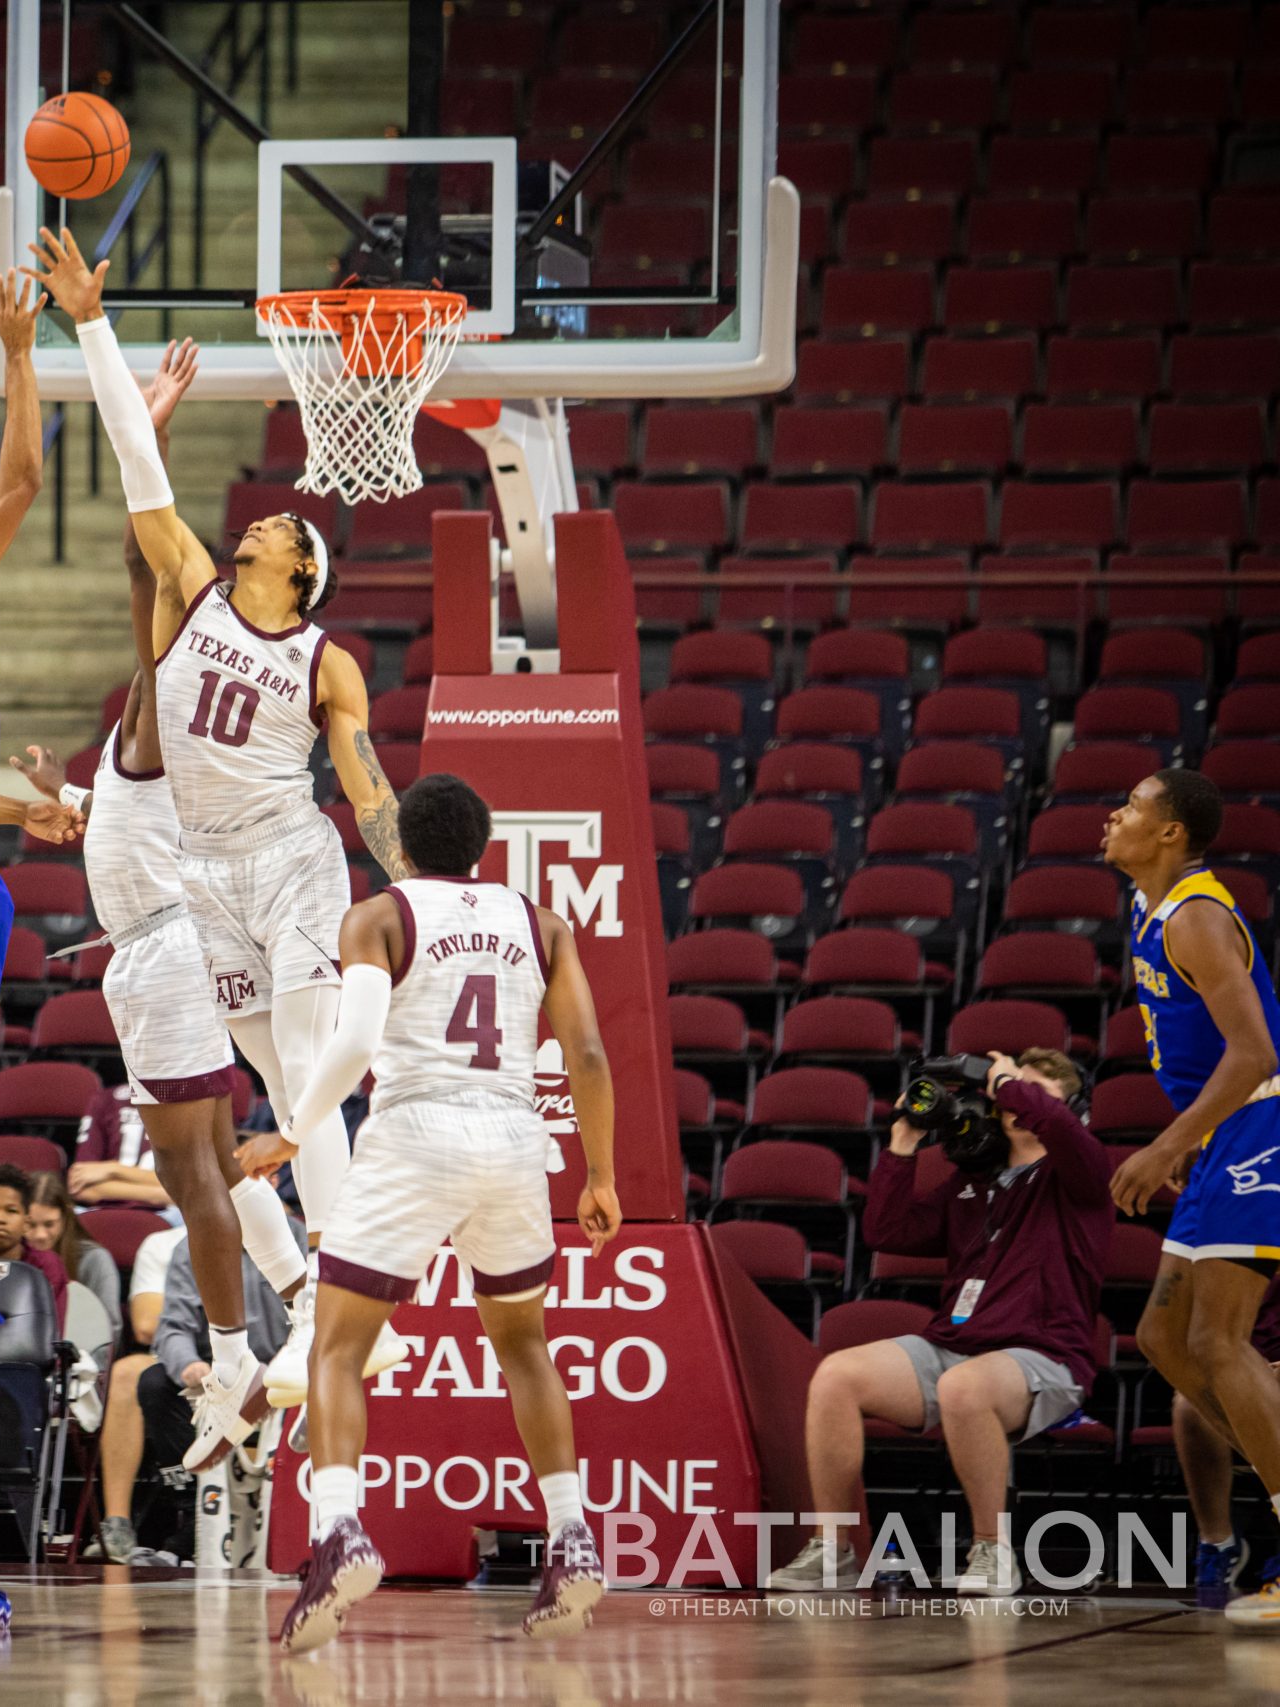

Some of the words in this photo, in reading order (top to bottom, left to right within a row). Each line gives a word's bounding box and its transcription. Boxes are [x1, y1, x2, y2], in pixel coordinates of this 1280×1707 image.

[188, 631, 254, 675] TEXAS
[255, 666, 301, 703] A&M
[188, 670, 261, 748] 10
[428, 708, 619, 727] www.opportune.com
[426, 933, 500, 963] TAYLOR
[502, 942, 528, 967] IV
[446, 974, 503, 1070] 4
[296, 1454, 719, 1515] PPORUNE
